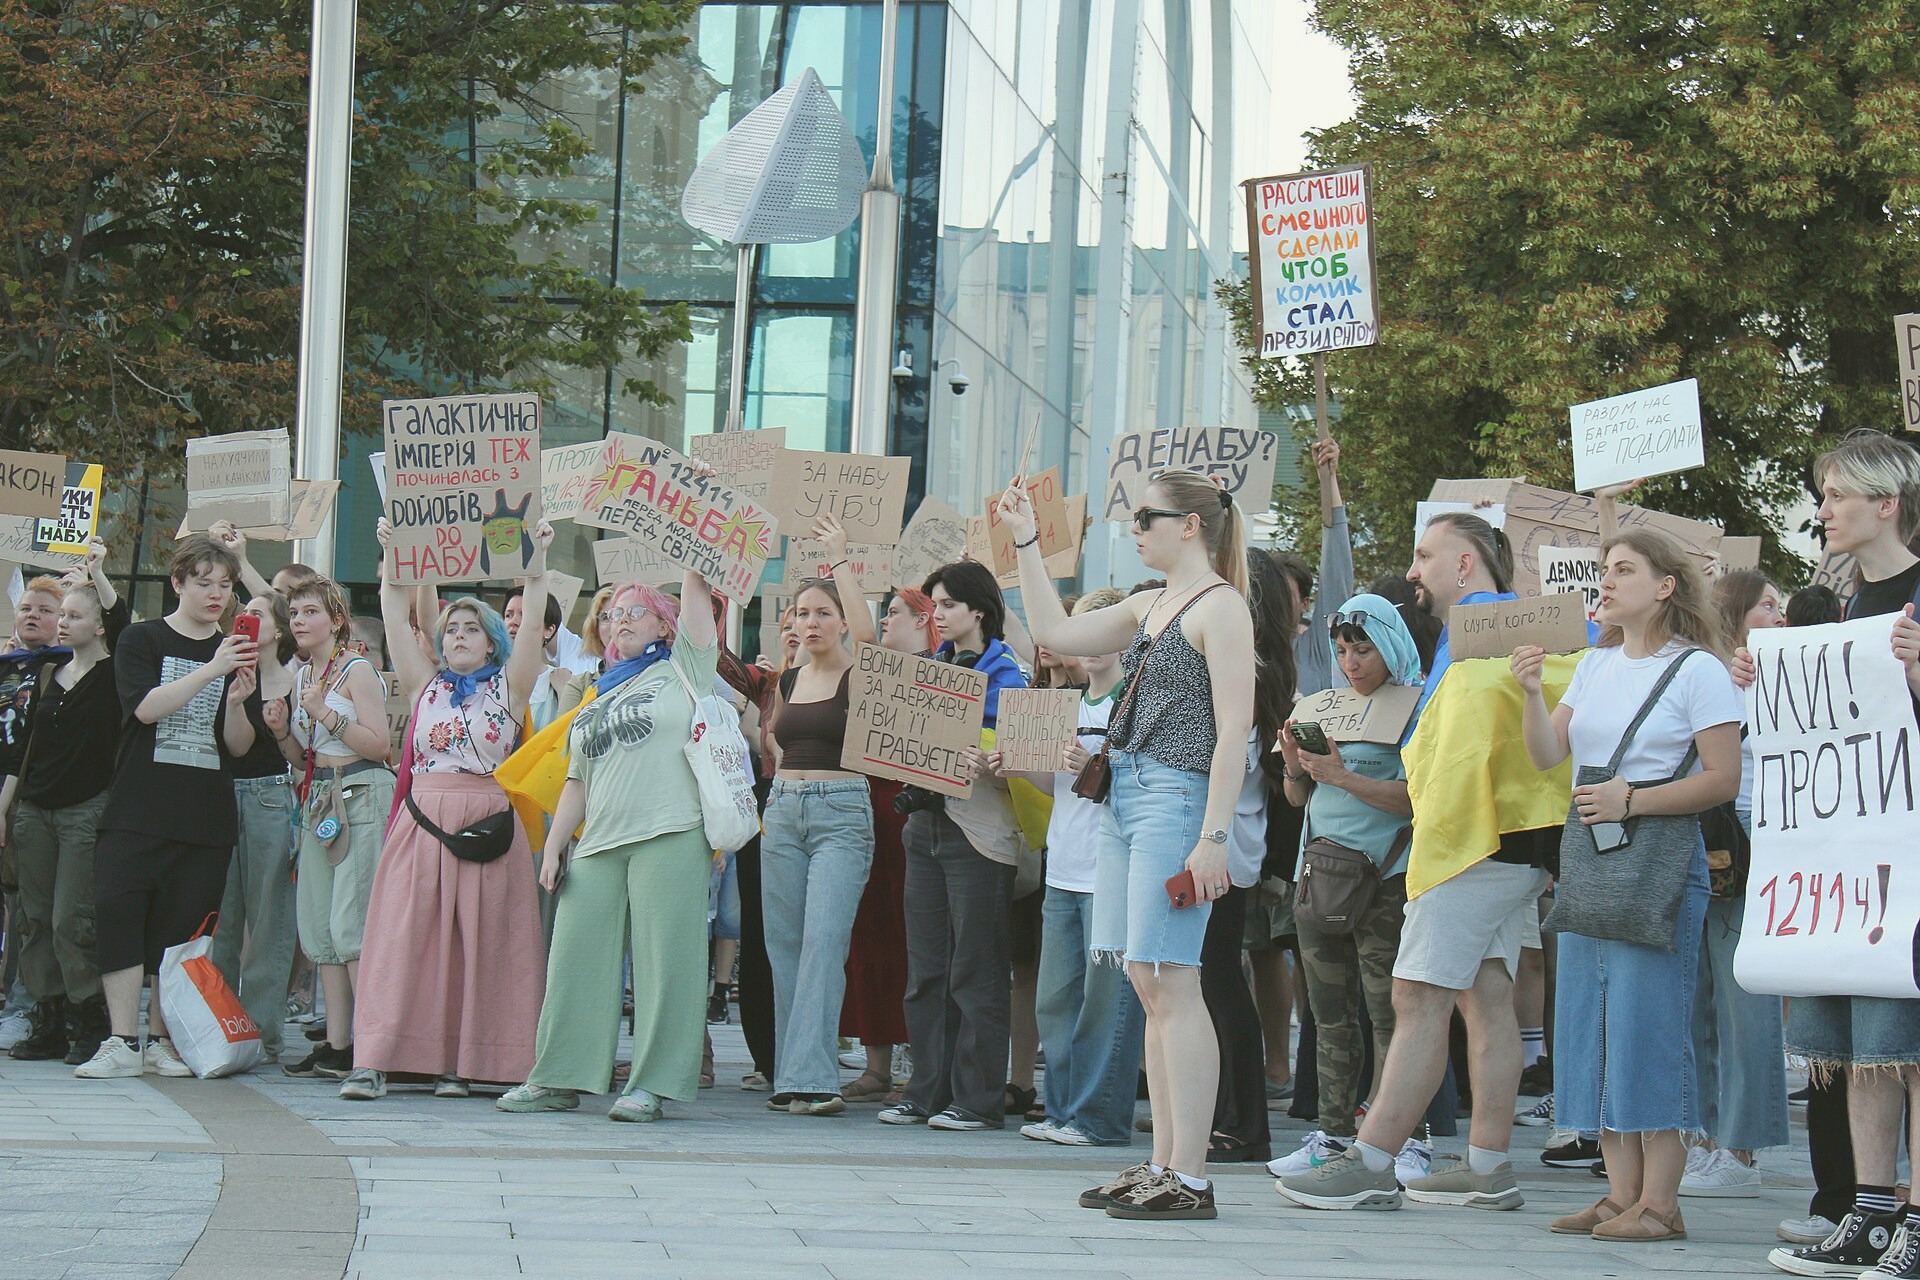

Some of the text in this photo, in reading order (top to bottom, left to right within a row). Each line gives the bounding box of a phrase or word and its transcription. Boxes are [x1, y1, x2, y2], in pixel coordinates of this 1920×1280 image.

[1262, 173, 1359, 210] РАССМЕШИ
[1281, 252, 1348, 282] ЧТОБ
[1276, 275, 1362, 305] КОМИК
[1287, 299, 1354, 329] СТАЛ
[1583, 394, 1671, 424] РАЗОМ НАС
[1646, 413, 1672, 426] НАС
[488, 437, 531, 464] ТЕЖ
[1616, 424, 1700, 464] ПОДОЛАТИ
[203, 450, 270, 470] НАХУЯЧИЛИ
[803, 460, 890, 489] ЗА НАБУ
[210, 476, 221, 487] НА
[670, 462, 734, 512] 12414
[609, 464, 748, 562] ГАНЬБА
[1106, 480, 1131, 519] А
[40, 526, 89, 544] НАБУ
[598, 505, 657, 541] ПЕРЕД
[623, 498, 723, 562] ПЕРЕД ЛЮДЬМИ
[394, 545, 478, 581] НАБУ
[1545, 559, 1602, 585] ДЕМОКР
[1464, 617, 1496, 634] СЛУГИ
[860, 647, 983, 697] ВОНИ ВОЮЮТЬ
[863, 675, 883, 697] ЗА
[1755, 640, 1860, 736] МИ!
[856, 699, 867, 719] А
[872, 702, 898, 731] ВИ
[1757, 726, 1914, 832] ПРОТИ
[1759, 863, 1892, 945] 12414!
